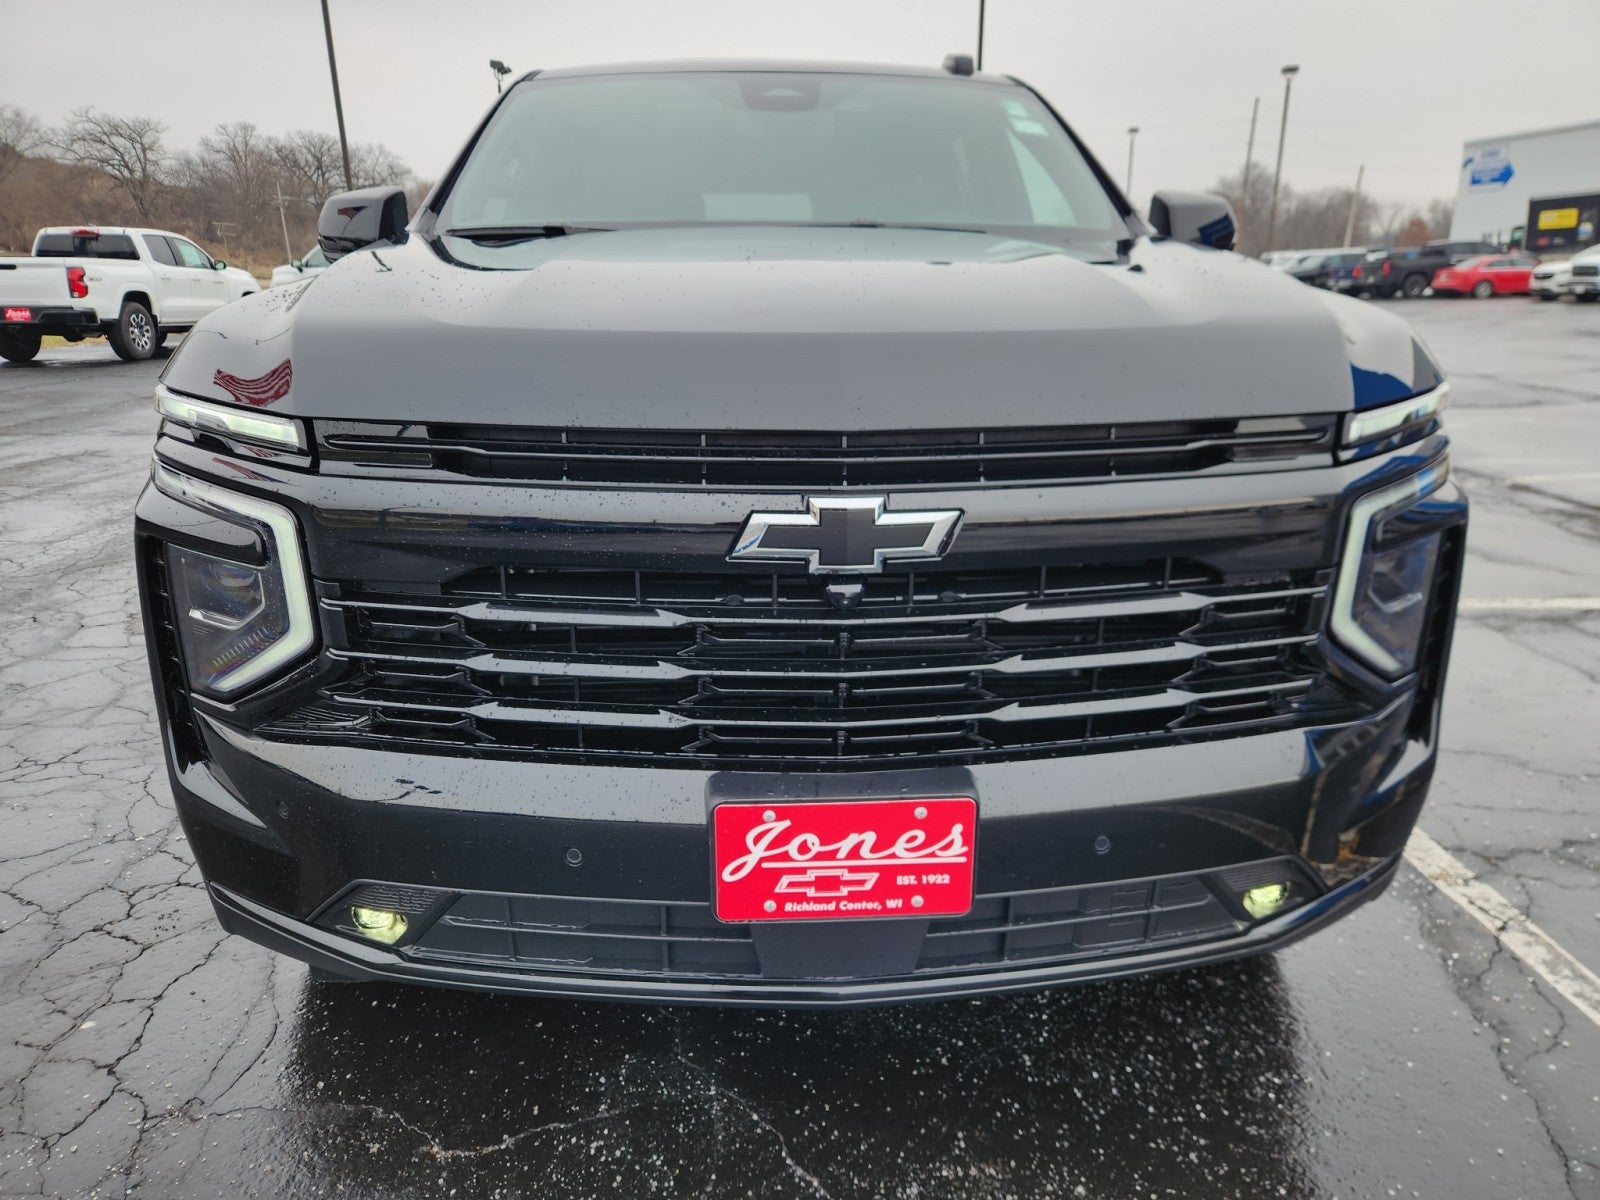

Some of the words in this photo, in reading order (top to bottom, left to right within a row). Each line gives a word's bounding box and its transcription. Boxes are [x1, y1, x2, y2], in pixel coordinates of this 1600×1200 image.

[721, 819, 969, 882] Jones
[896, 875, 918, 886] EST.
[921, 873, 951, 885] 1922
[784, 901, 836, 912] Richland
[838, 900, 883, 911] Center,
[885, 898, 903, 909] WI
